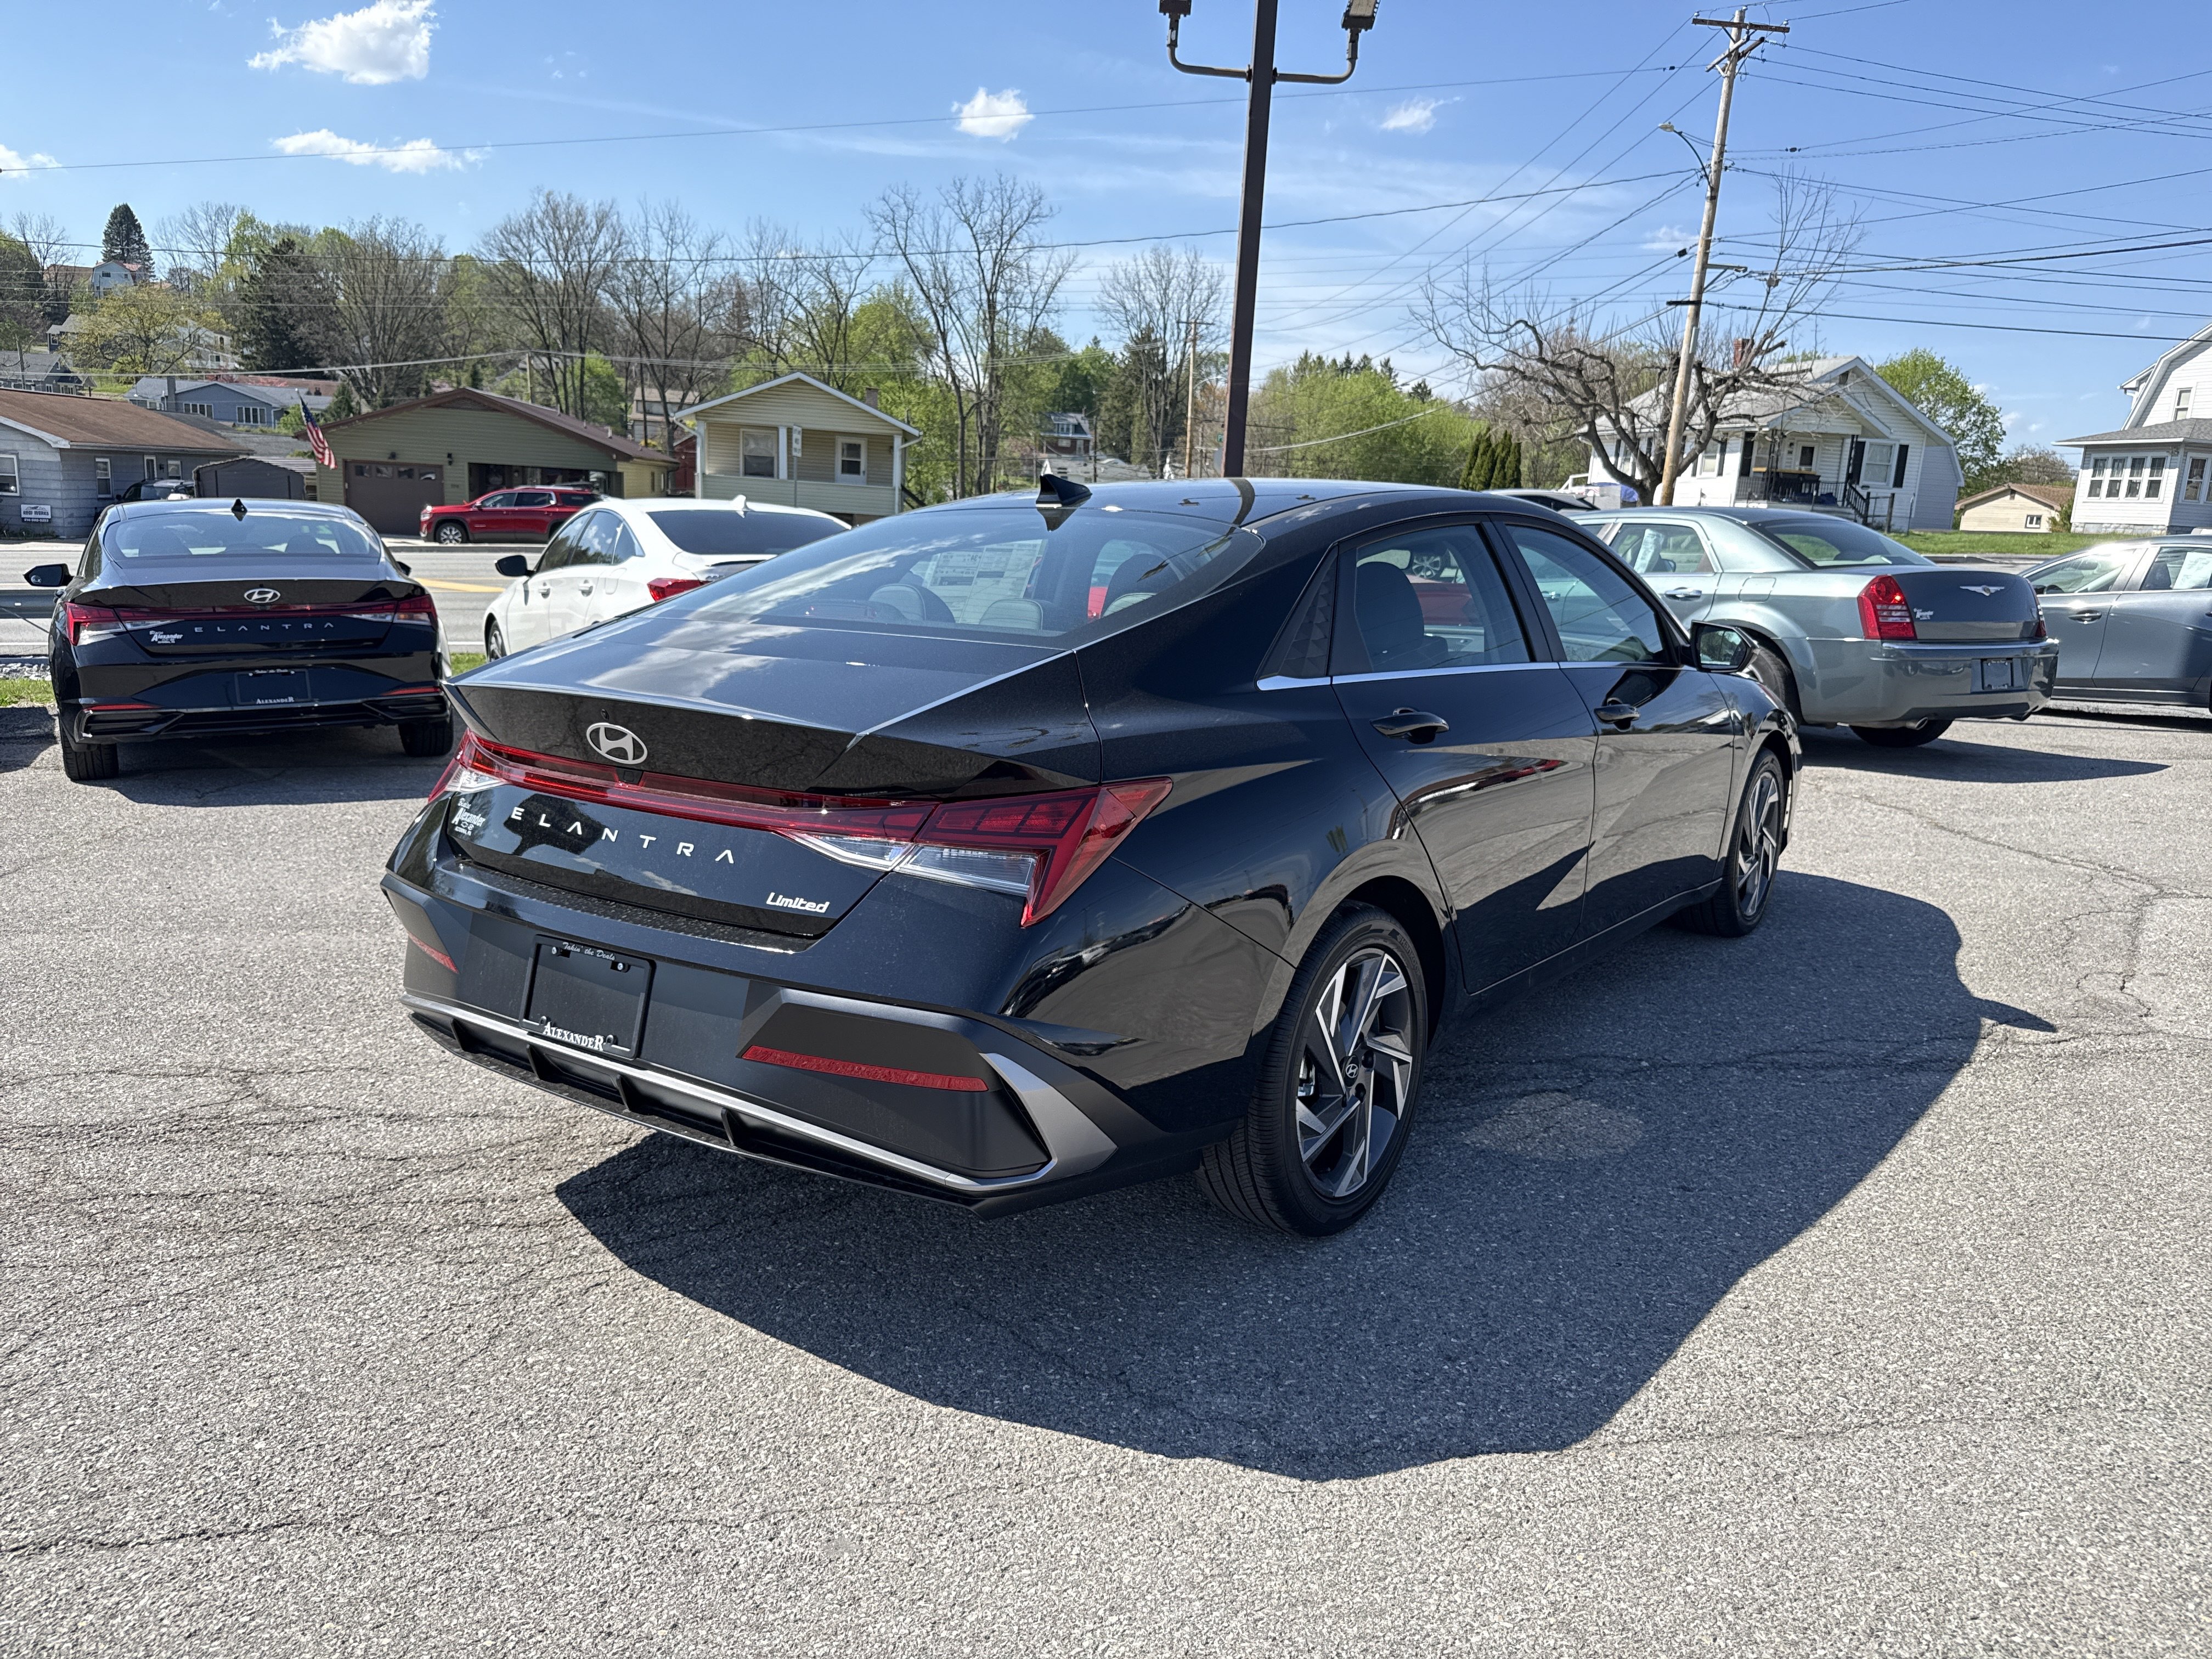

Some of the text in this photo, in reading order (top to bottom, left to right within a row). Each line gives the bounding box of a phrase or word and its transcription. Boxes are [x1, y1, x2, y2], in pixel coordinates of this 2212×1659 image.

[194, 622, 334, 633] ELANTRA
[452, 807, 486, 827] Alexander
[510, 806, 734, 864] ELANTRA
[766, 891, 830, 913] Limited
[562, 941, 615, 961] Takin' the Deals
[543, 1021, 604, 1051] ALEXANDER
